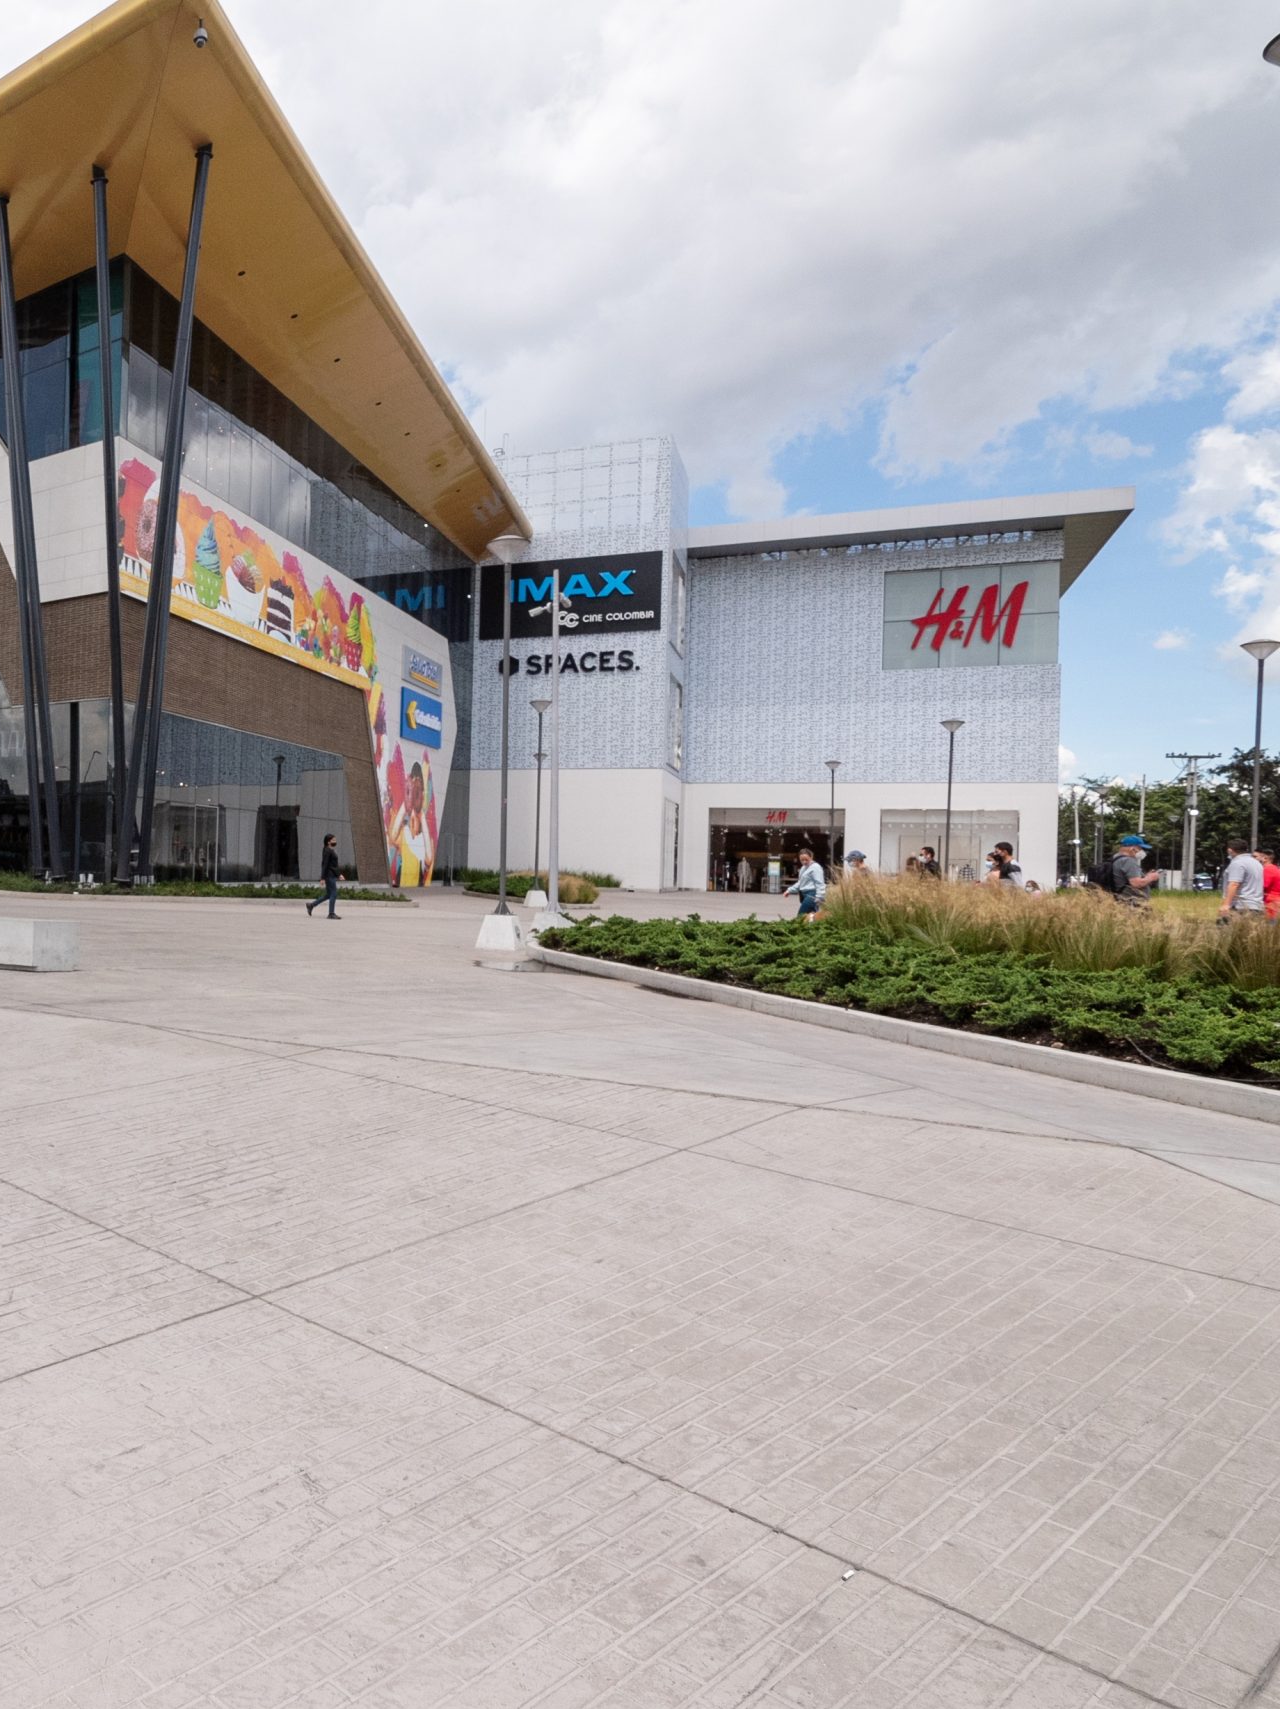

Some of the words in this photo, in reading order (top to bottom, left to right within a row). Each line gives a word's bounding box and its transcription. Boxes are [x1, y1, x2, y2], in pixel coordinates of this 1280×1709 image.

[508, 570, 634, 603] IMAX
[583, 613, 603, 623] CINE
[605, 610, 655, 622] COLOMBIA
[911, 581, 1029, 652] H&M
